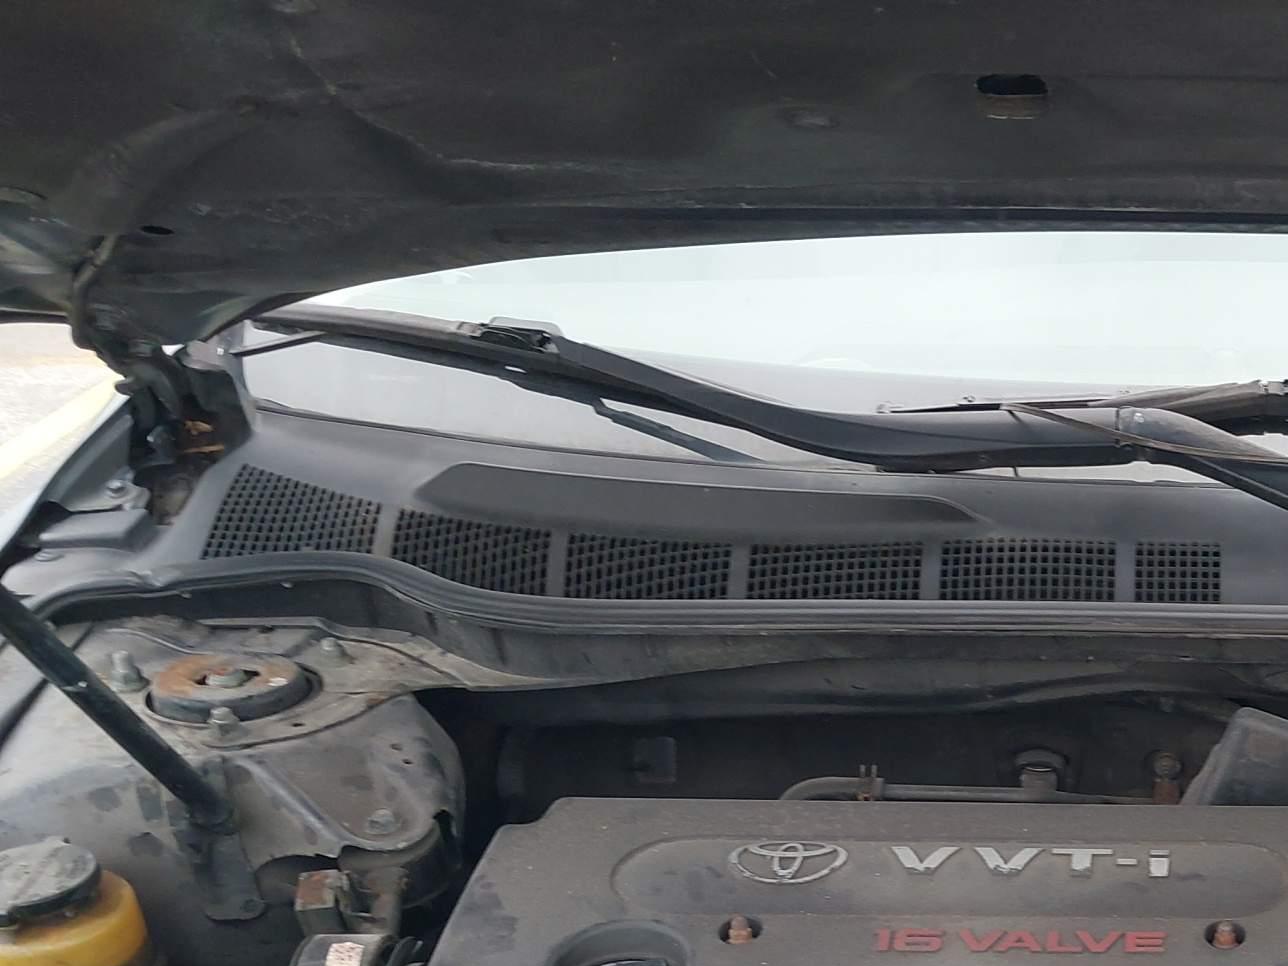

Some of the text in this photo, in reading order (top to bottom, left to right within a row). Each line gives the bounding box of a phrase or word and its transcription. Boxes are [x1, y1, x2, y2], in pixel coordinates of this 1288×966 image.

[890, 846, 1170, 878] VVT-i
[875, 927, 1169, 954] 16 VALVE
